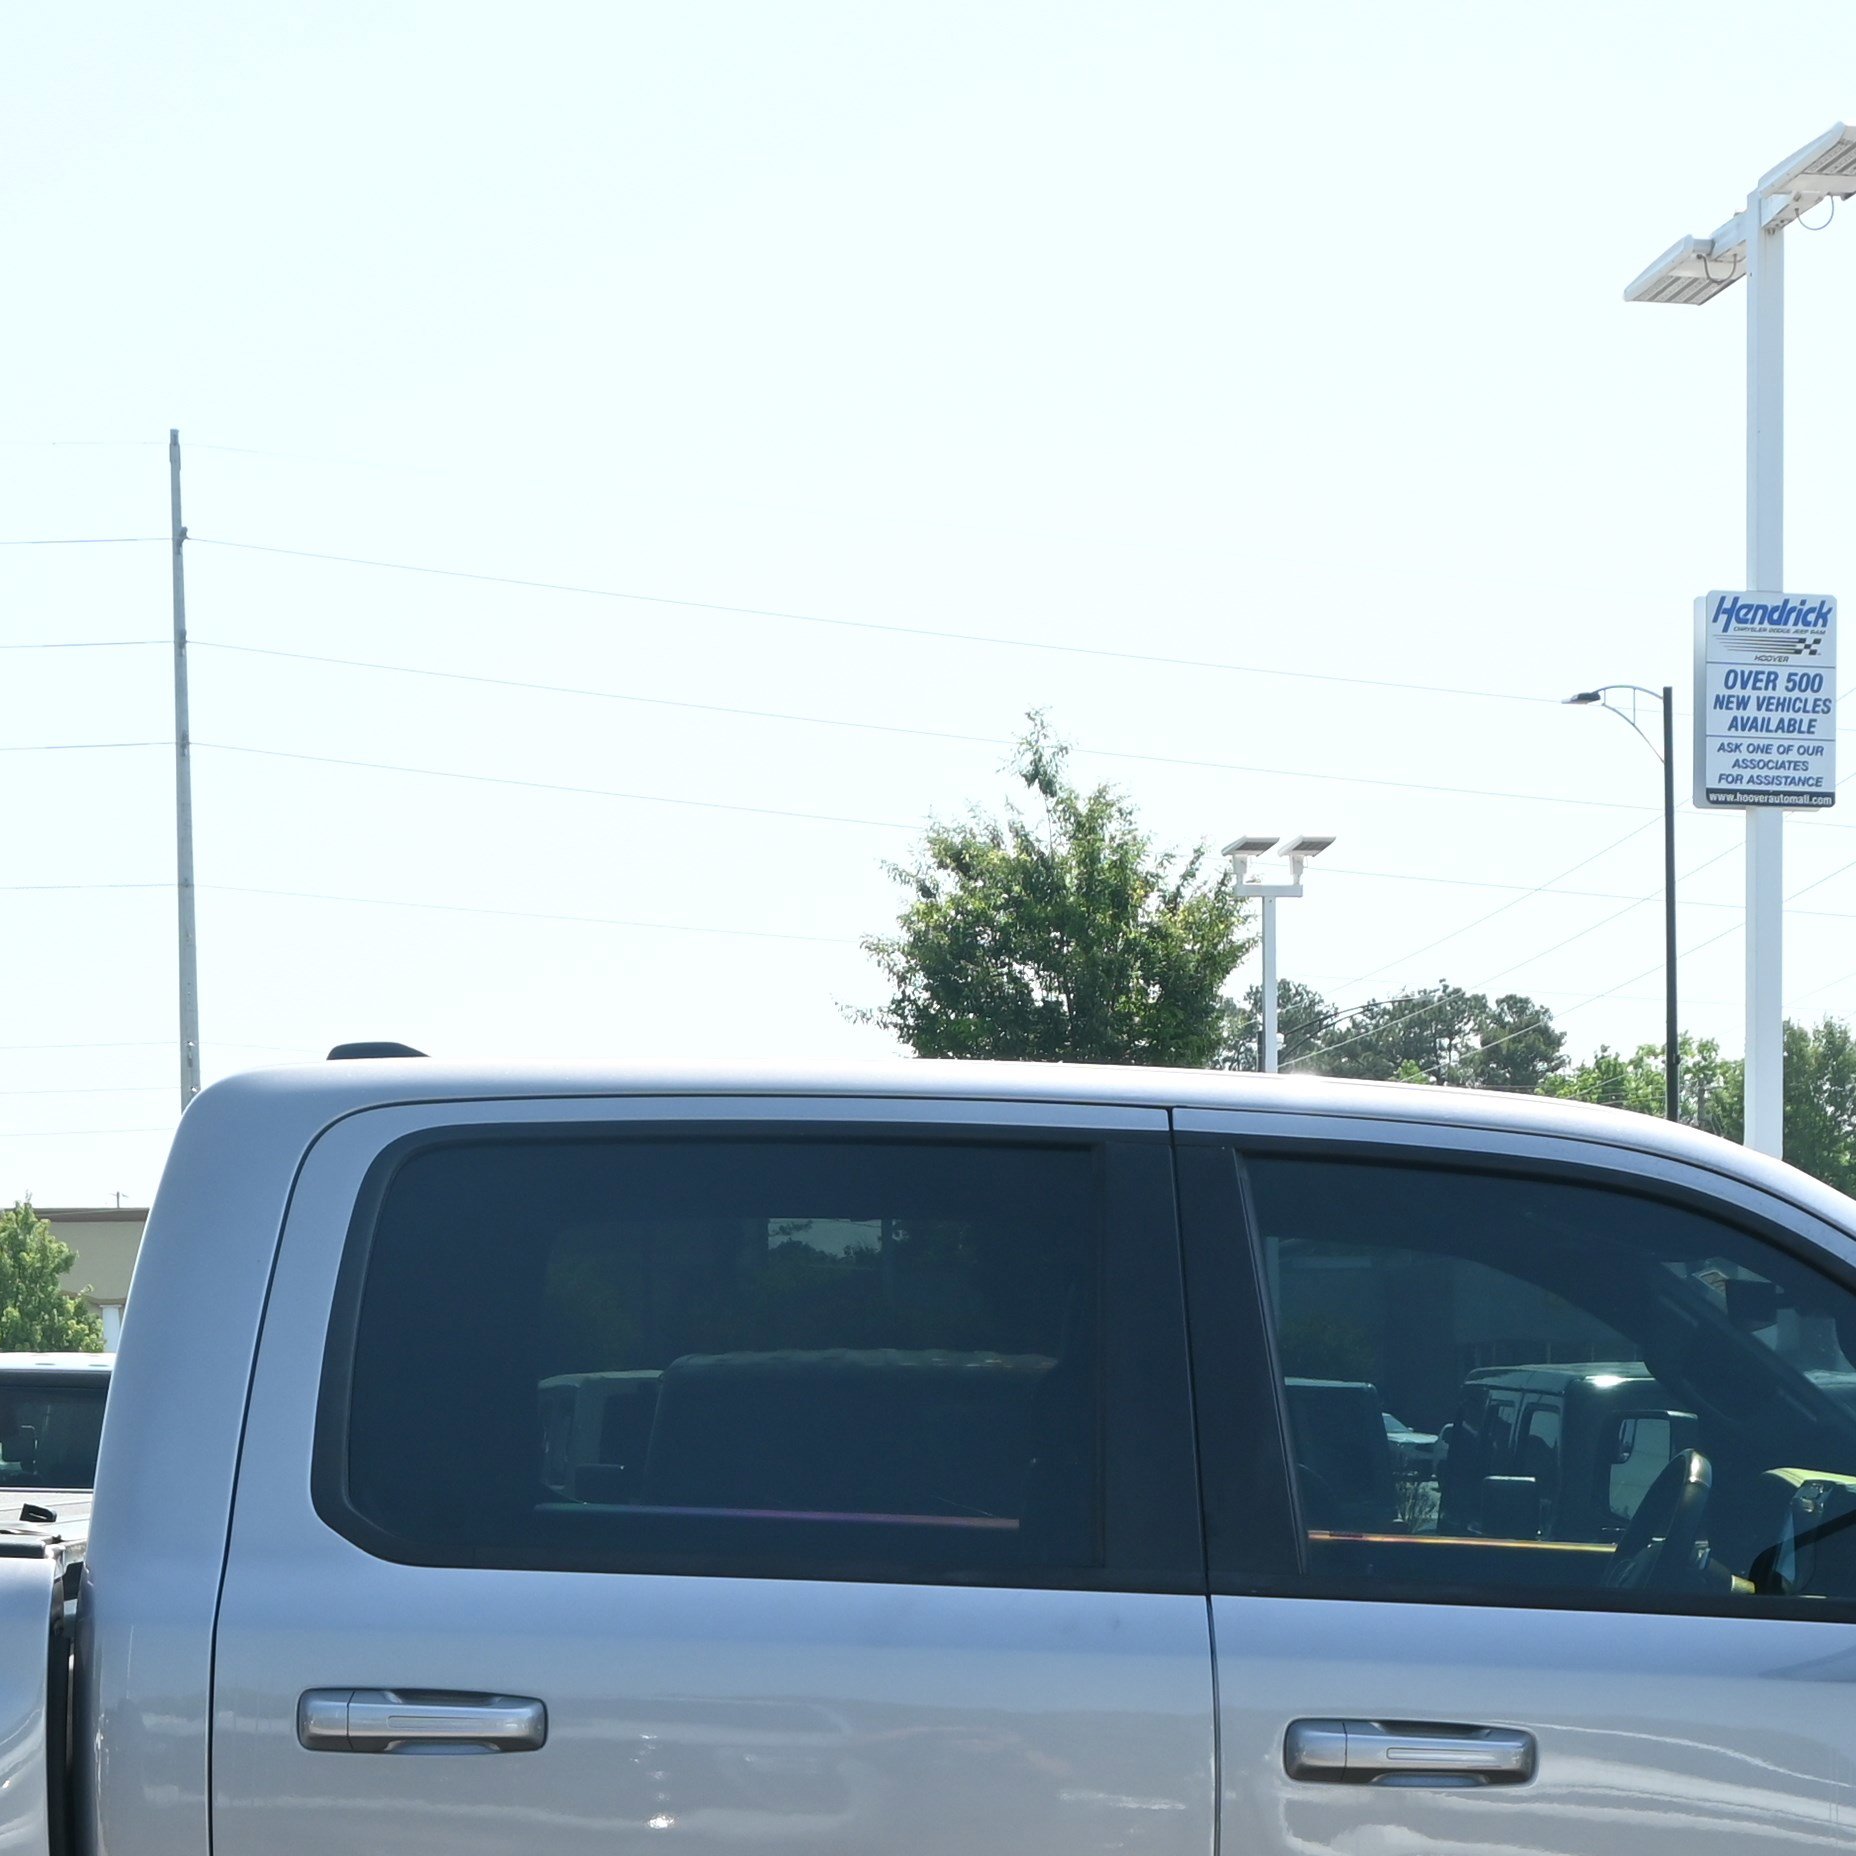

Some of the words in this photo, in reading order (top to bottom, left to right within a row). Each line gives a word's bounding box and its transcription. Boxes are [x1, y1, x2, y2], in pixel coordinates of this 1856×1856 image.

[1712, 596, 1833, 633] Hendrick
[1754, 655, 1789, 663] HOOVER
[1724, 669, 1779, 691] OVER
[1785, 672, 1824, 693] 500
[1713, 694, 1751, 711] NEW
[1756, 695, 1832, 714] VEHICLES
[1727, 715, 1817, 734] AVAILABLE
[1717, 742, 1743, 753] ASK
[1746, 743, 1773, 754] ONE
[1776, 744, 1794, 755] OF
[1797, 745, 1824, 756] OUR
[1732, 759, 1809, 771] ASSOCIATES
[1718, 774, 1744, 784] FOR
[1746, 775, 1824, 787] ASSISTANCE
[1709, 792, 1832, 805] www.hooverautomall.com
